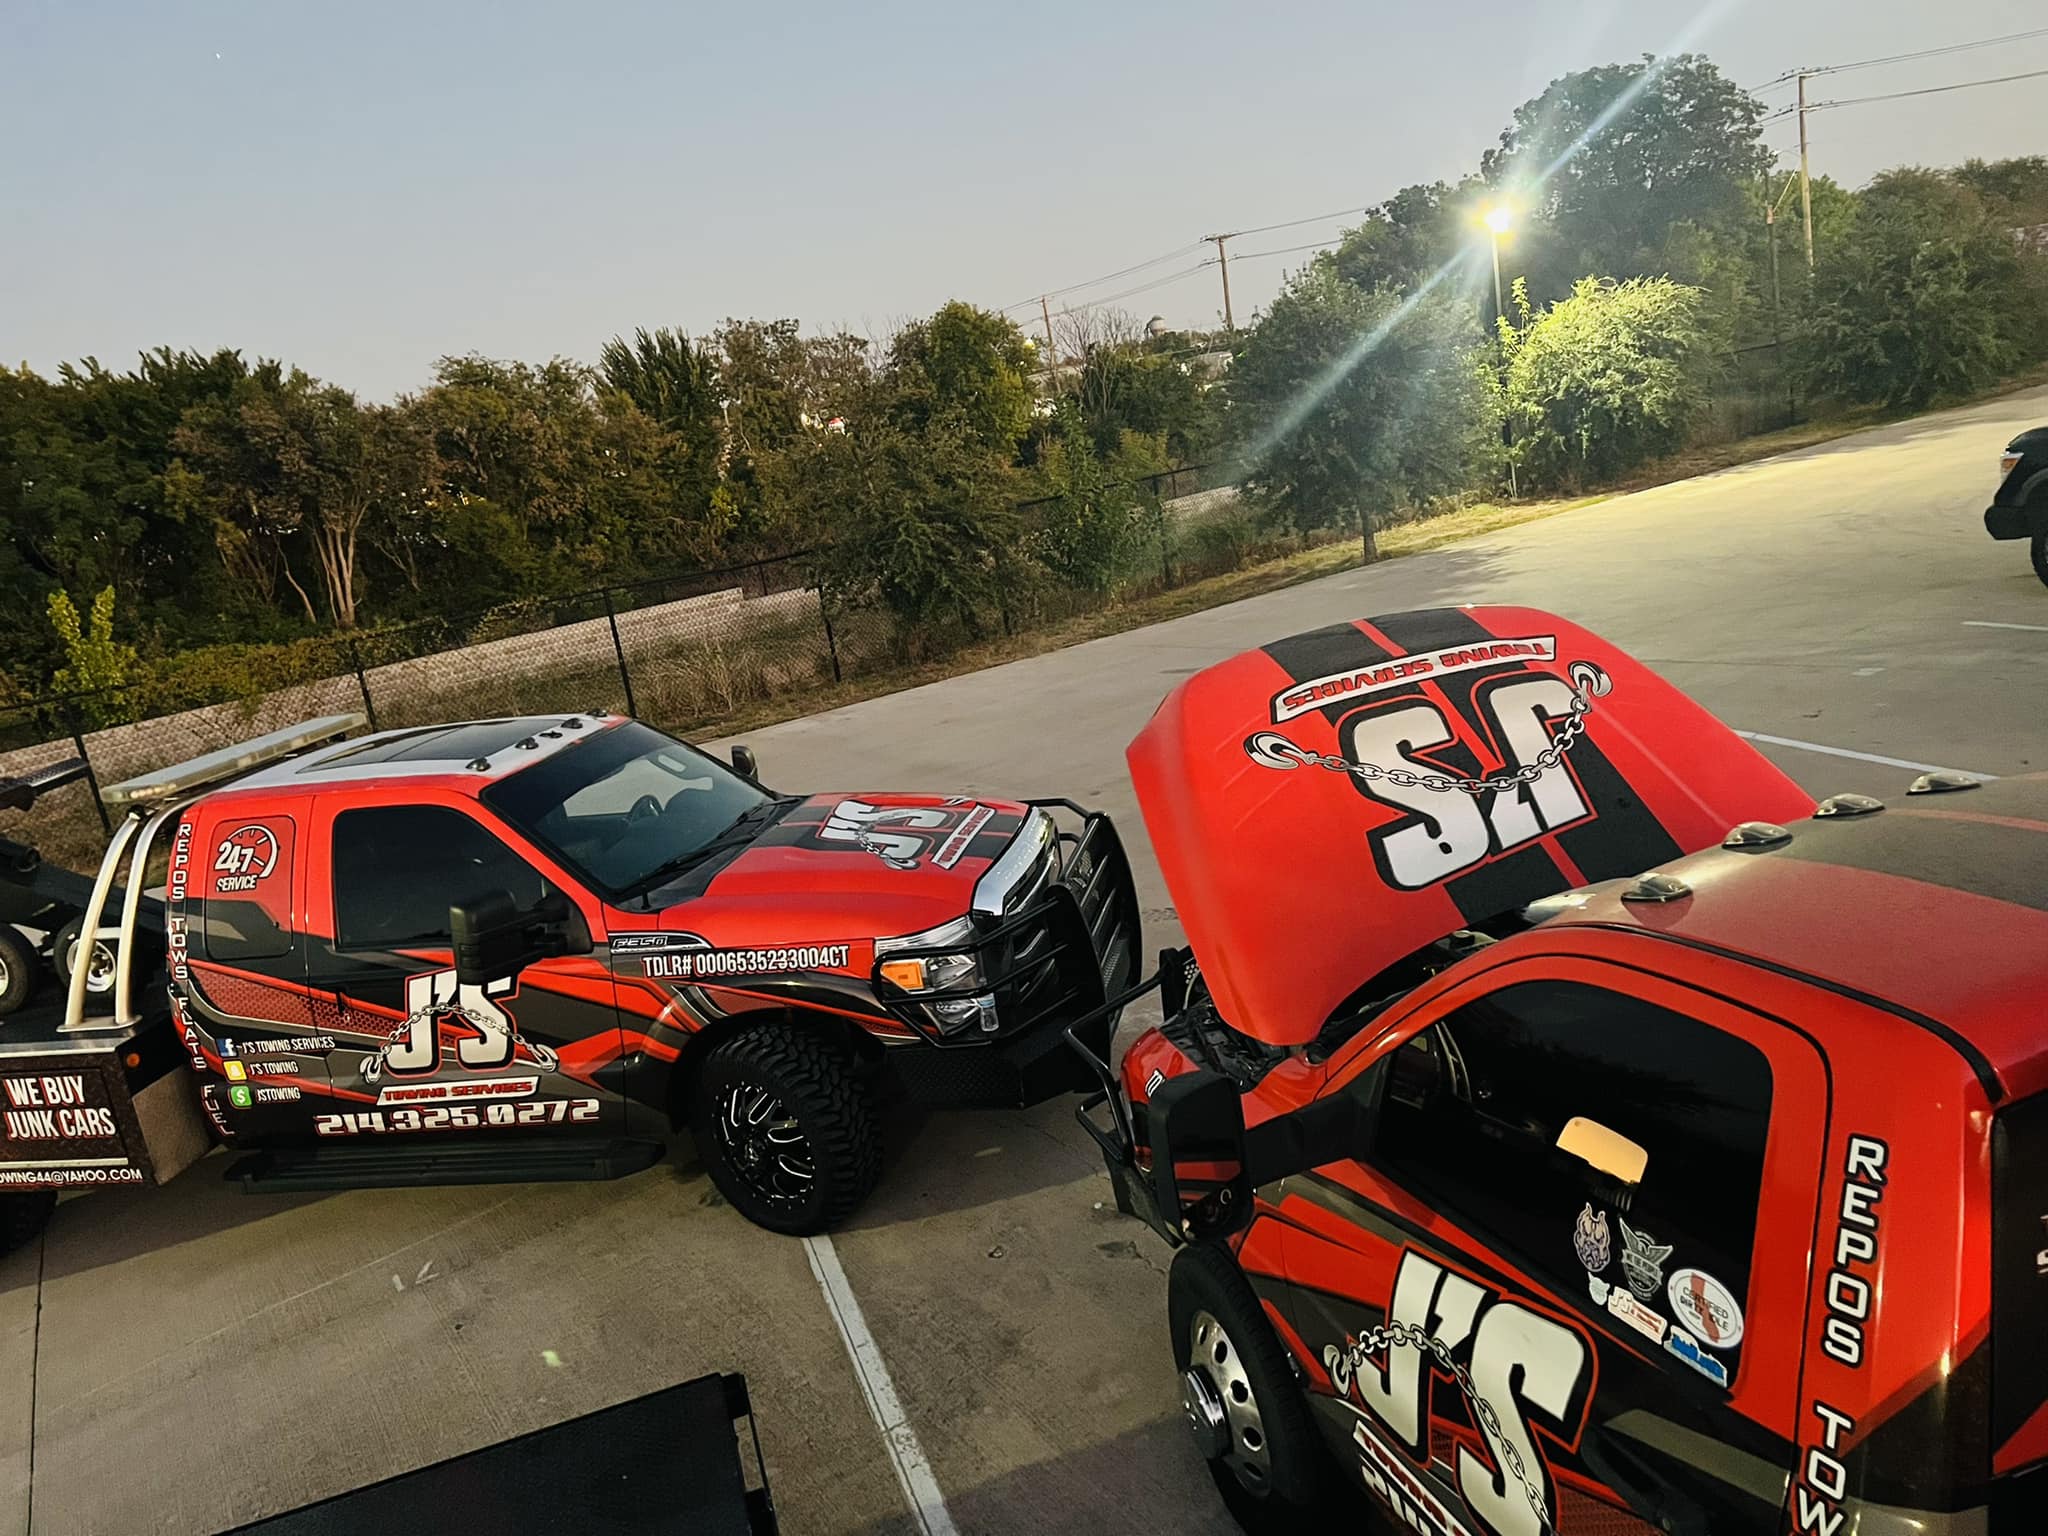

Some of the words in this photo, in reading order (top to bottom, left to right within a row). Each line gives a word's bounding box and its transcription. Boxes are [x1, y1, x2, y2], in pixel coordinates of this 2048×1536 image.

[1440, 642, 1552, 668] TOWING
[1282, 658, 1434, 711] SERVICES
[1353, 679, 1589, 887] J'S
[172, 823, 192, 900] REPOS
[216, 874, 258, 892] SERVICE
[171, 917, 188, 979] TOWS
[643, 955, 692, 977] TDLR#
[178, 997, 207, 1069] FLATS
[242, 1041, 256, 1055] J'S
[255, 1039, 291, 1053] TOWING
[291, 1036, 335, 1049] SERVICES
[250, 1063, 264, 1075] J'S
[264, 1061, 299, 1074] TOWING
[6, 1077, 44, 1106] WE
[43, 1075, 86, 1105] BUY
[383, 1088, 447, 1102] TOWING
[451, 1081, 535, 1096] SERVICES
[7, 1110, 60, 1138] JUNK
[60, 1108, 117, 1138] CARS
[203, 1084, 235, 1134] FUEL
[315, 1098, 600, 1136] 214.325.0272
[0, 1168, 143, 1185] WING44@YAHOO.COM
[1825, 1137, 1885, 1365] REPOS
[1355, 1250, 1585, 1536] J'S
